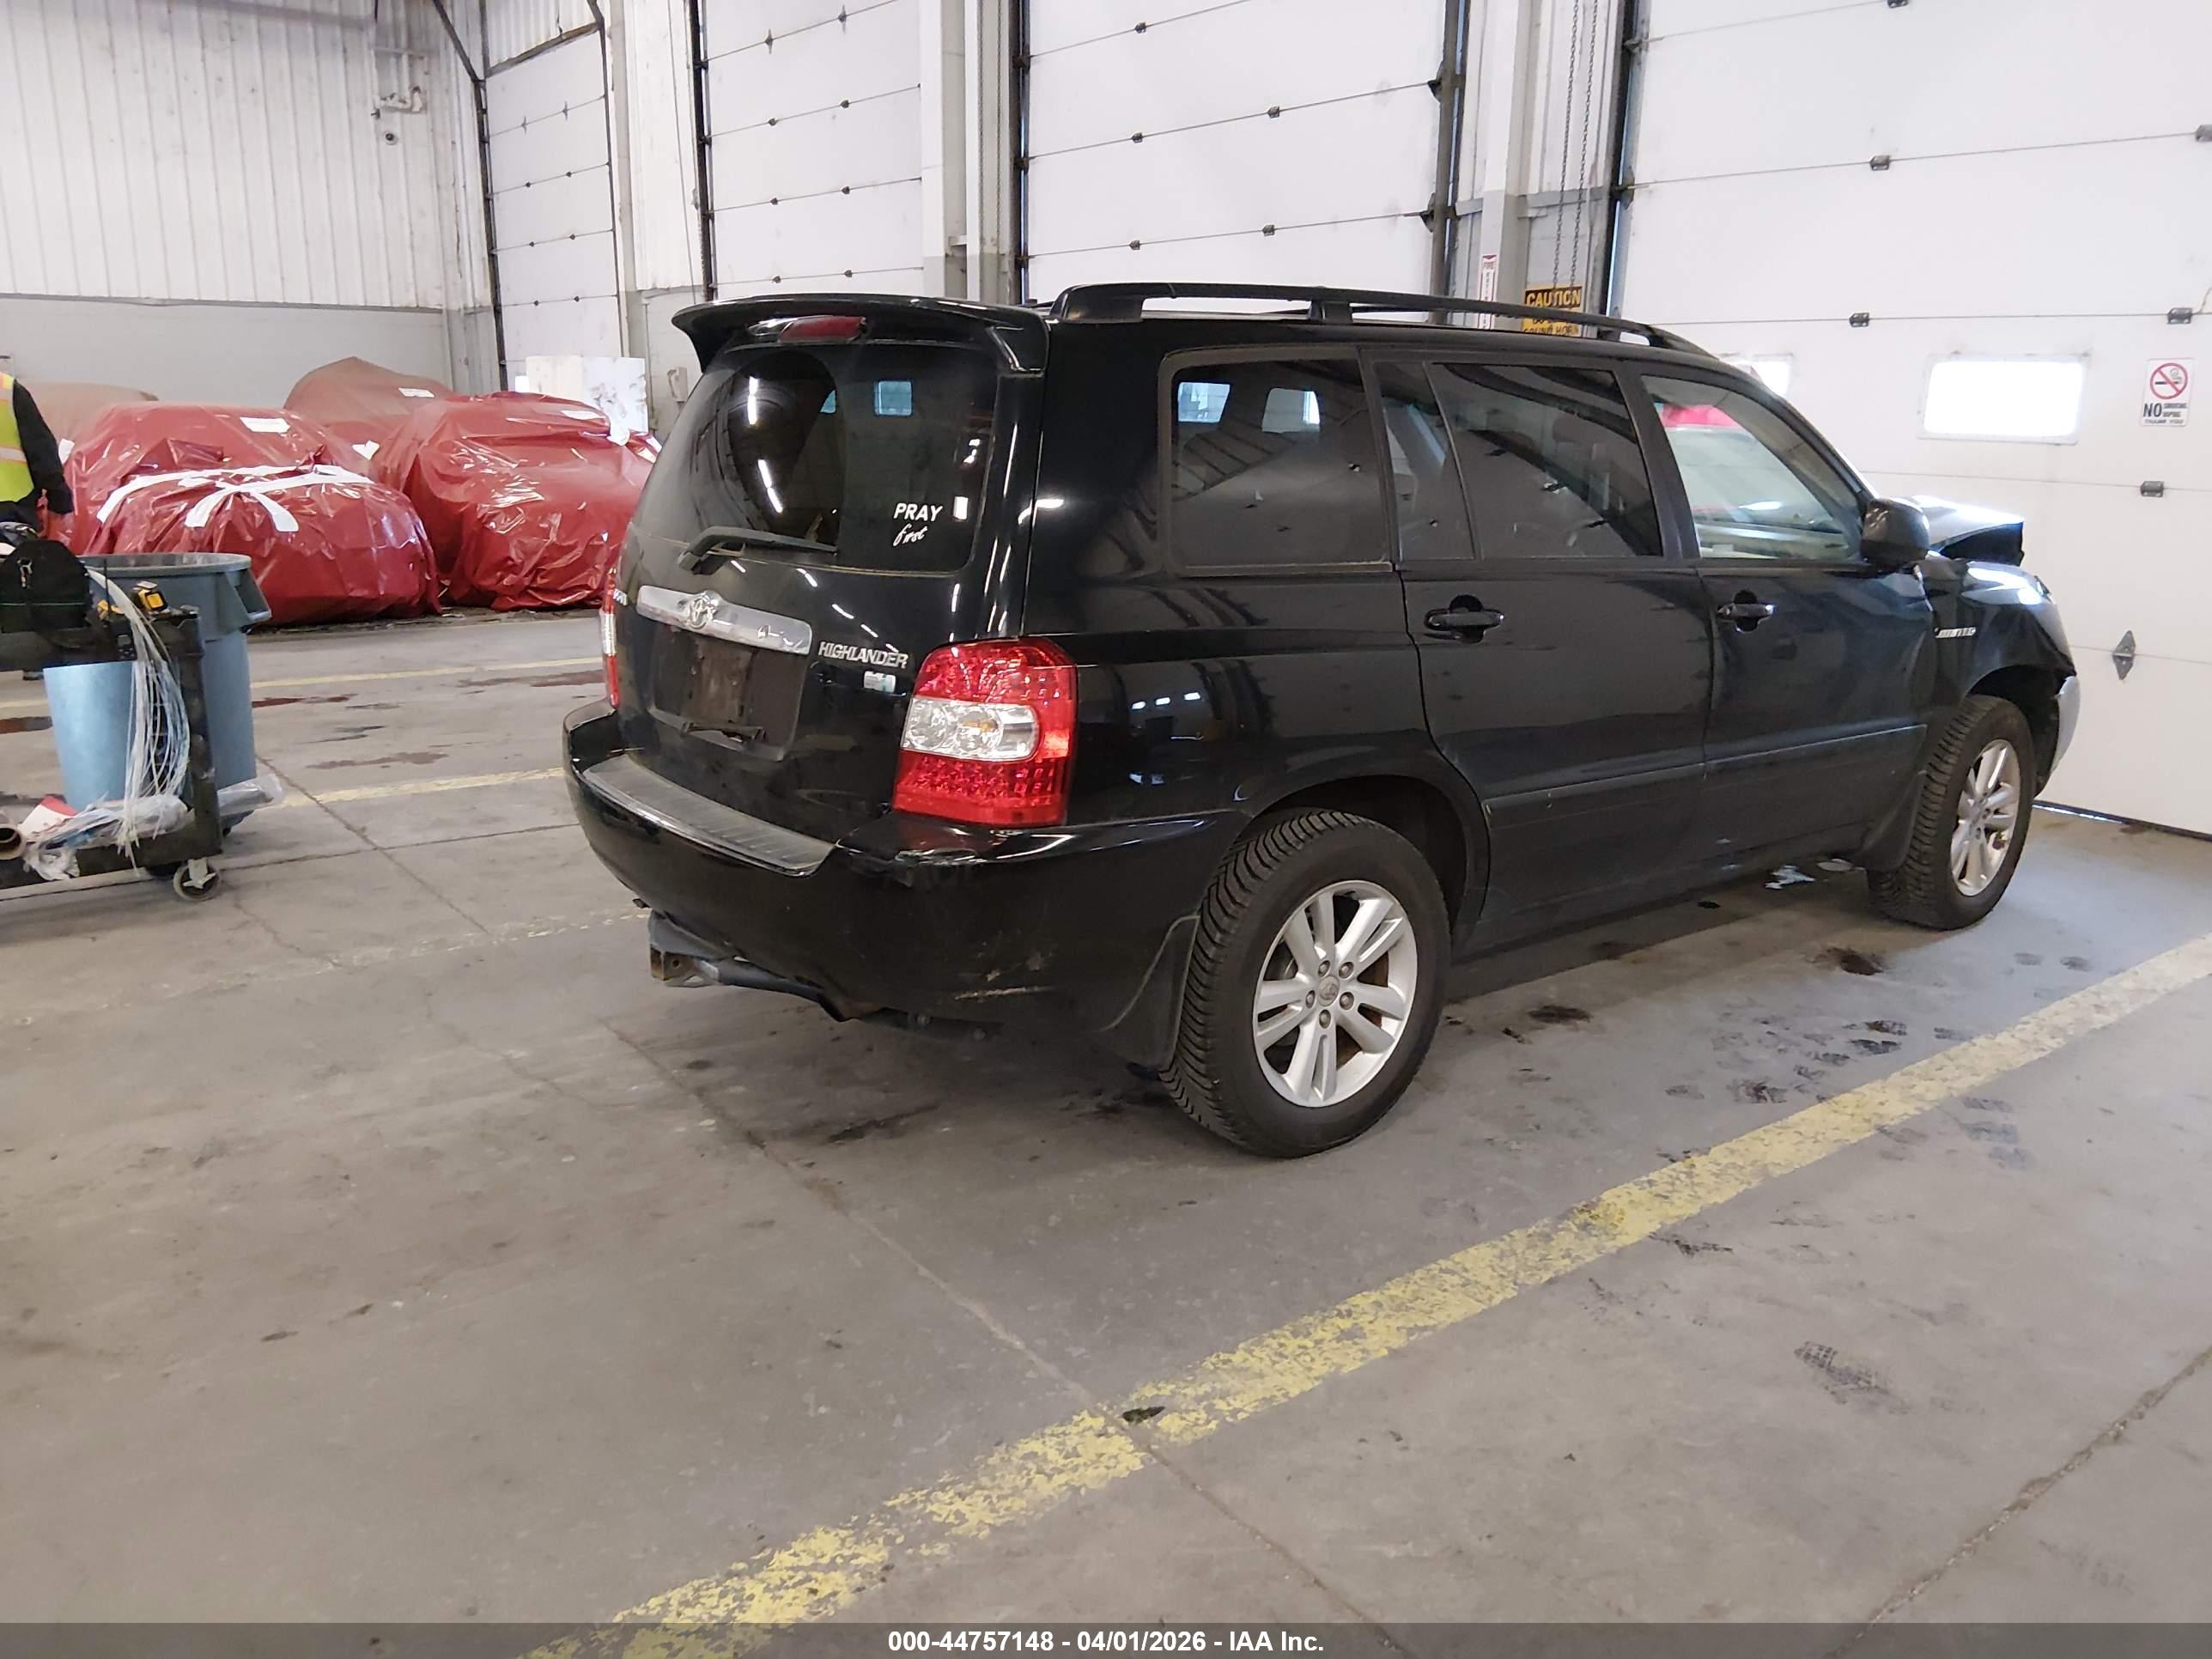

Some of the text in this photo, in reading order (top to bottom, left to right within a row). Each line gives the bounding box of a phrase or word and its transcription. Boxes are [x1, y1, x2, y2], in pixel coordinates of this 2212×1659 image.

[1527, 289, 1580, 307] CAUTION
[2143, 402, 2162, 417] NO
[893, 502, 943, 522] PRAY
[893, 523, 927, 546] first
[818, 641, 908, 669] HIGHLANDER
